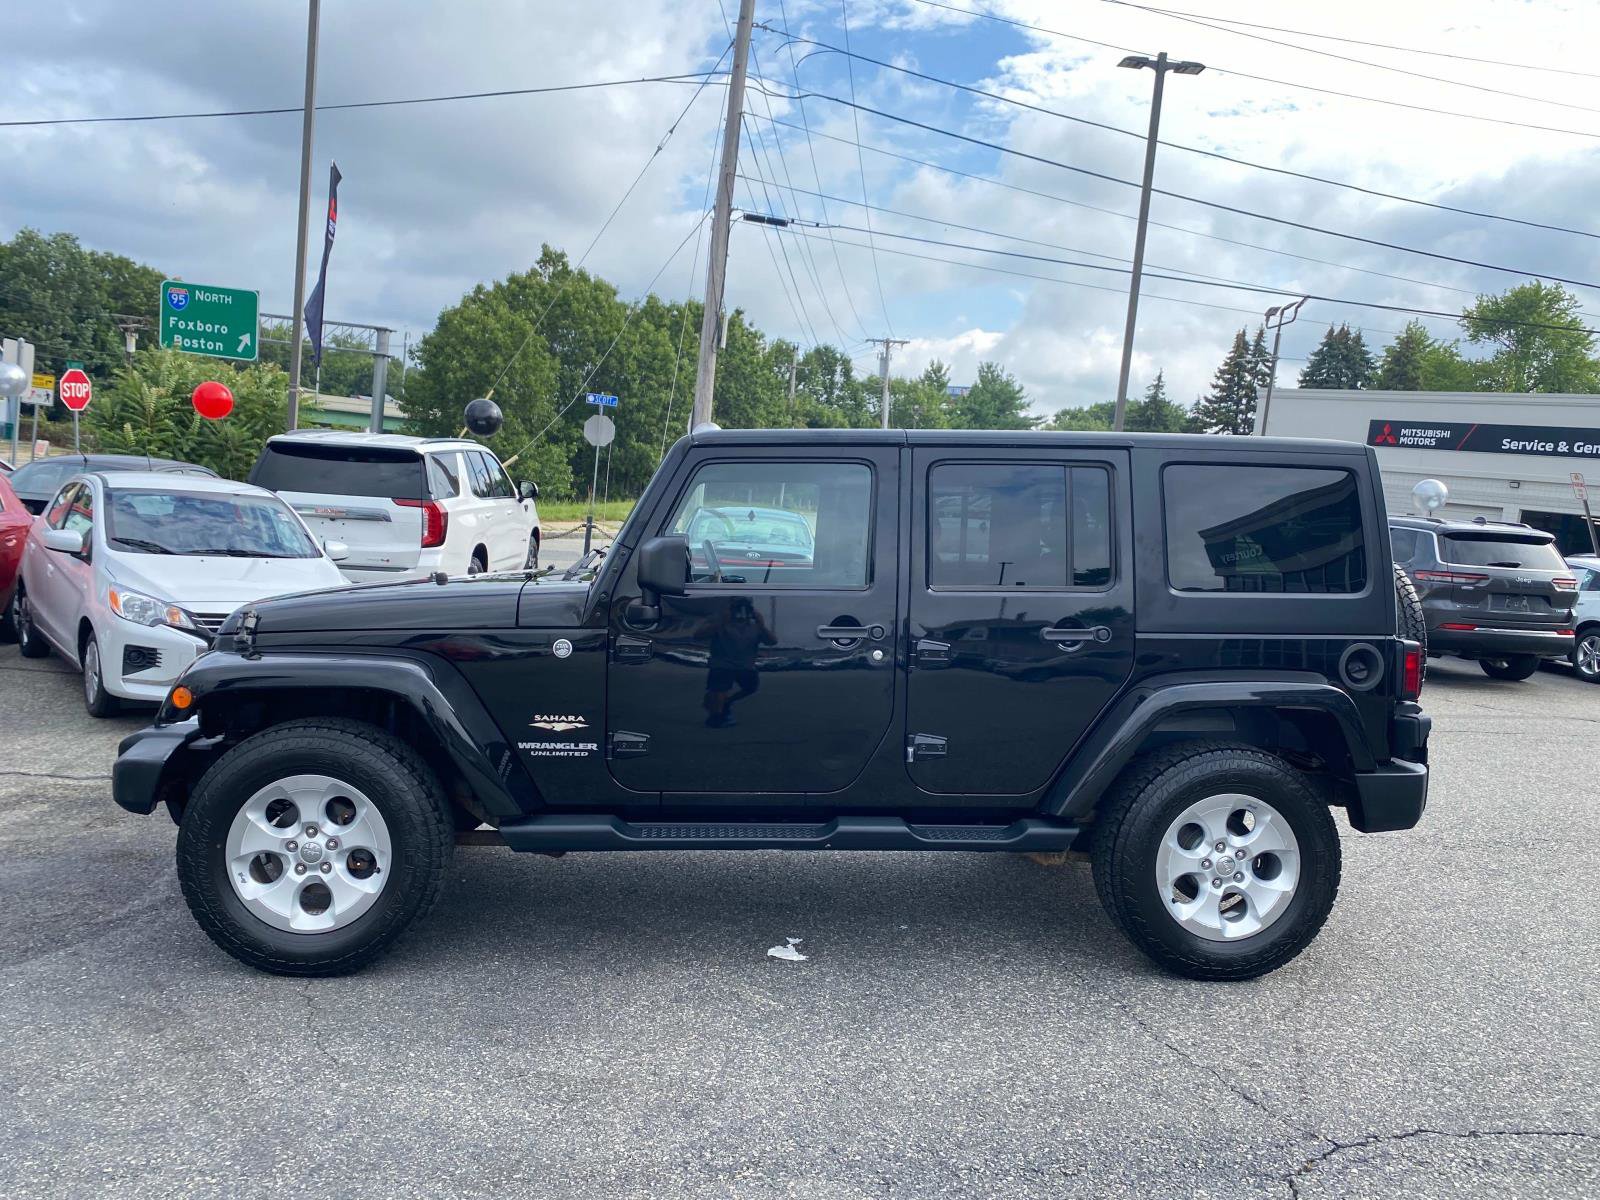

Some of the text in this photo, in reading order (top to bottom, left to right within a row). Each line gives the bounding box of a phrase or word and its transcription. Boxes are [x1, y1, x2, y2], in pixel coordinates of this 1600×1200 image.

[171, 290, 232, 305] 95 NORTH
[169, 316, 228, 334] Foxboro
[173, 334, 223, 351] Boston
[63, 383, 88, 398] STOP
[1401, 428, 1451, 438] MITSUBISHI
[1400, 437, 1436, 446] MOTORS
[1502, 438, 1554, 452] Service
[1557, 441, 1569, 453] &
[534, 714, 585, 722] SAHARA
[518, 742, 598, 751] WRANGLER
